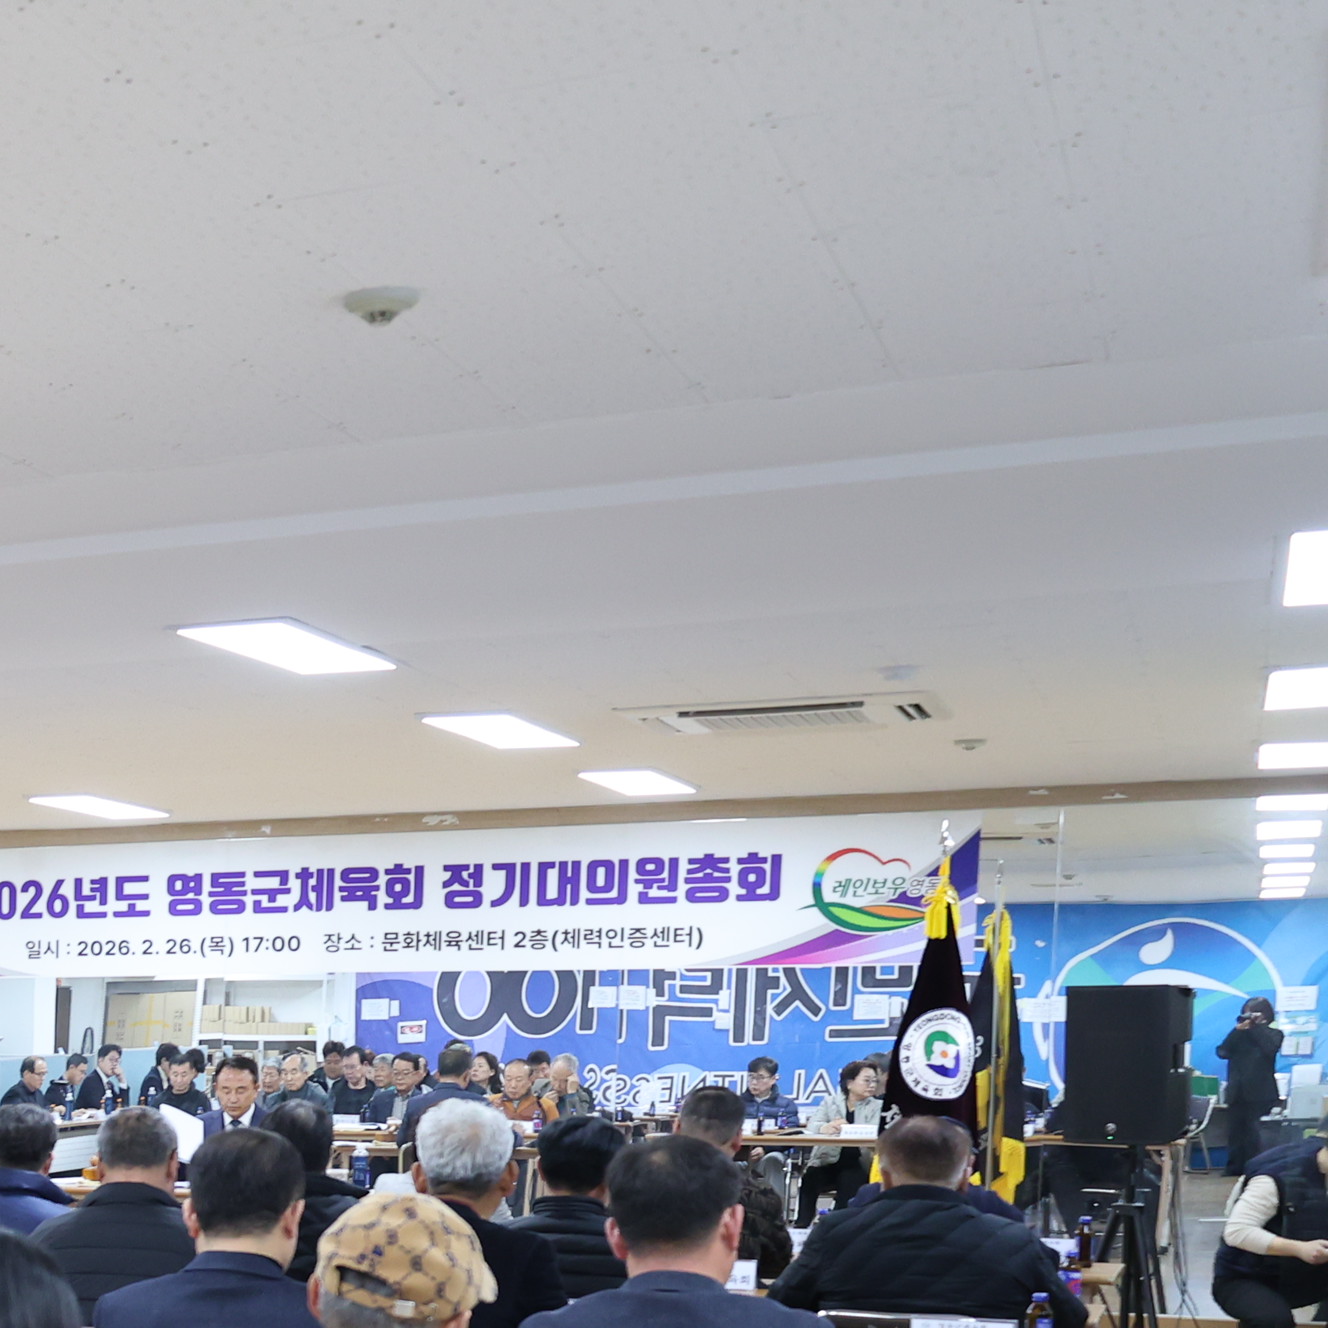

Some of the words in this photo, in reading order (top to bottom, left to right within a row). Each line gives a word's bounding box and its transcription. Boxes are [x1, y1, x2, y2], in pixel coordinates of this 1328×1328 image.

[166, 863, 425, 917] 영동군체육회
[442, 852, 783, 909] 정기대의원총회
[25, 938, 61, 959] 일시
[77, 940, 136, 957] 2026.
[142, 938, 159, 956] 2.
[165, 935, 235, 958] 26.(목)
[242, 936, 301, 954] 17:00
[323, 932, 363, 953] 장소
[381, 929, 506, 952] 문화체육센터
[514, 925, 704, 952] 2층(체력인증센터)
